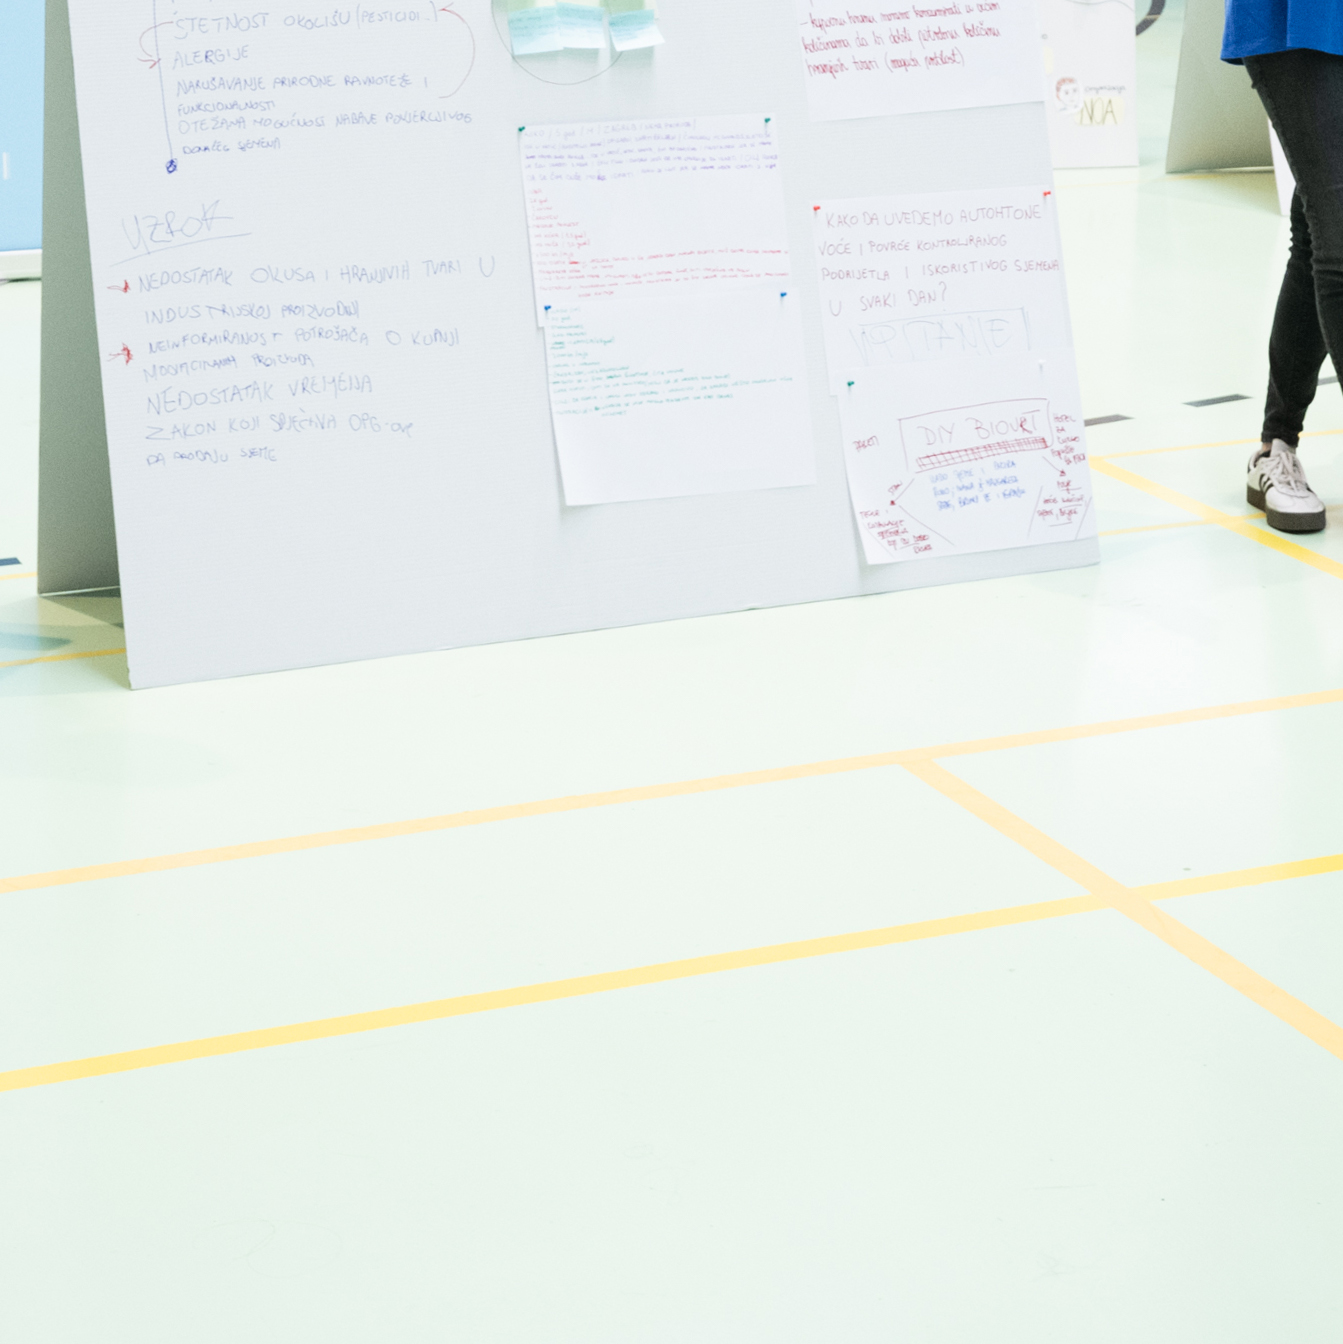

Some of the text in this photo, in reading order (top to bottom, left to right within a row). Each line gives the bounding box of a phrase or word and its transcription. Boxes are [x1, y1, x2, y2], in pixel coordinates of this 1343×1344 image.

[172, 10, 269, 39] ŠTETNOST
[282, 10, 351, 30] OKOLIŠU
[171, 45, 249, 70] ALERGIJE
[176, 76, 266, 97] NARUŠAVANJE
[272, 76, 336, 89] PRIRODNE
[177, 100, 276, 116] FUNKCIONALNOSTI
[1078, 97, 1118, 125] NOA
[177, 117, 246, 134] OTEŽANA
[825, 204, 1042, 228] KAKO DA UVEDEMO AUTOHTONE
[817, 237, 852, 256] VOĆE
[868, 239, 910, 253] POVRĆE
[915, 234, 1007, 251] KONTROLIRANOG
[137, 267, 233, 293] NEDOSTATAK
[250, 265, 315, 284] OKUSA
[421, 259, 461, 277] TVARI
[478, 256, 495, 278] U
[820, 267, 890, 281] PODRIJETLA
[921, 259, 1008, 275] ISKORISTIVOG
[1013, 259, 1060, 273] SJEMENA
[827, 300, 842, 317] U
[858, 292, 897, 311] SVAKI
[294, 325, 368, 345] POTROŠAČA
[384, 331, 401, 346] O
[146, 381, 273, 415] NEDOSTATAK
[145, 421, 216, 440] ZAKON
[228, 417, 259, 432] KOJI
[916, 423, 955, 445] DIY
[146, 453, 166, 466] DA
